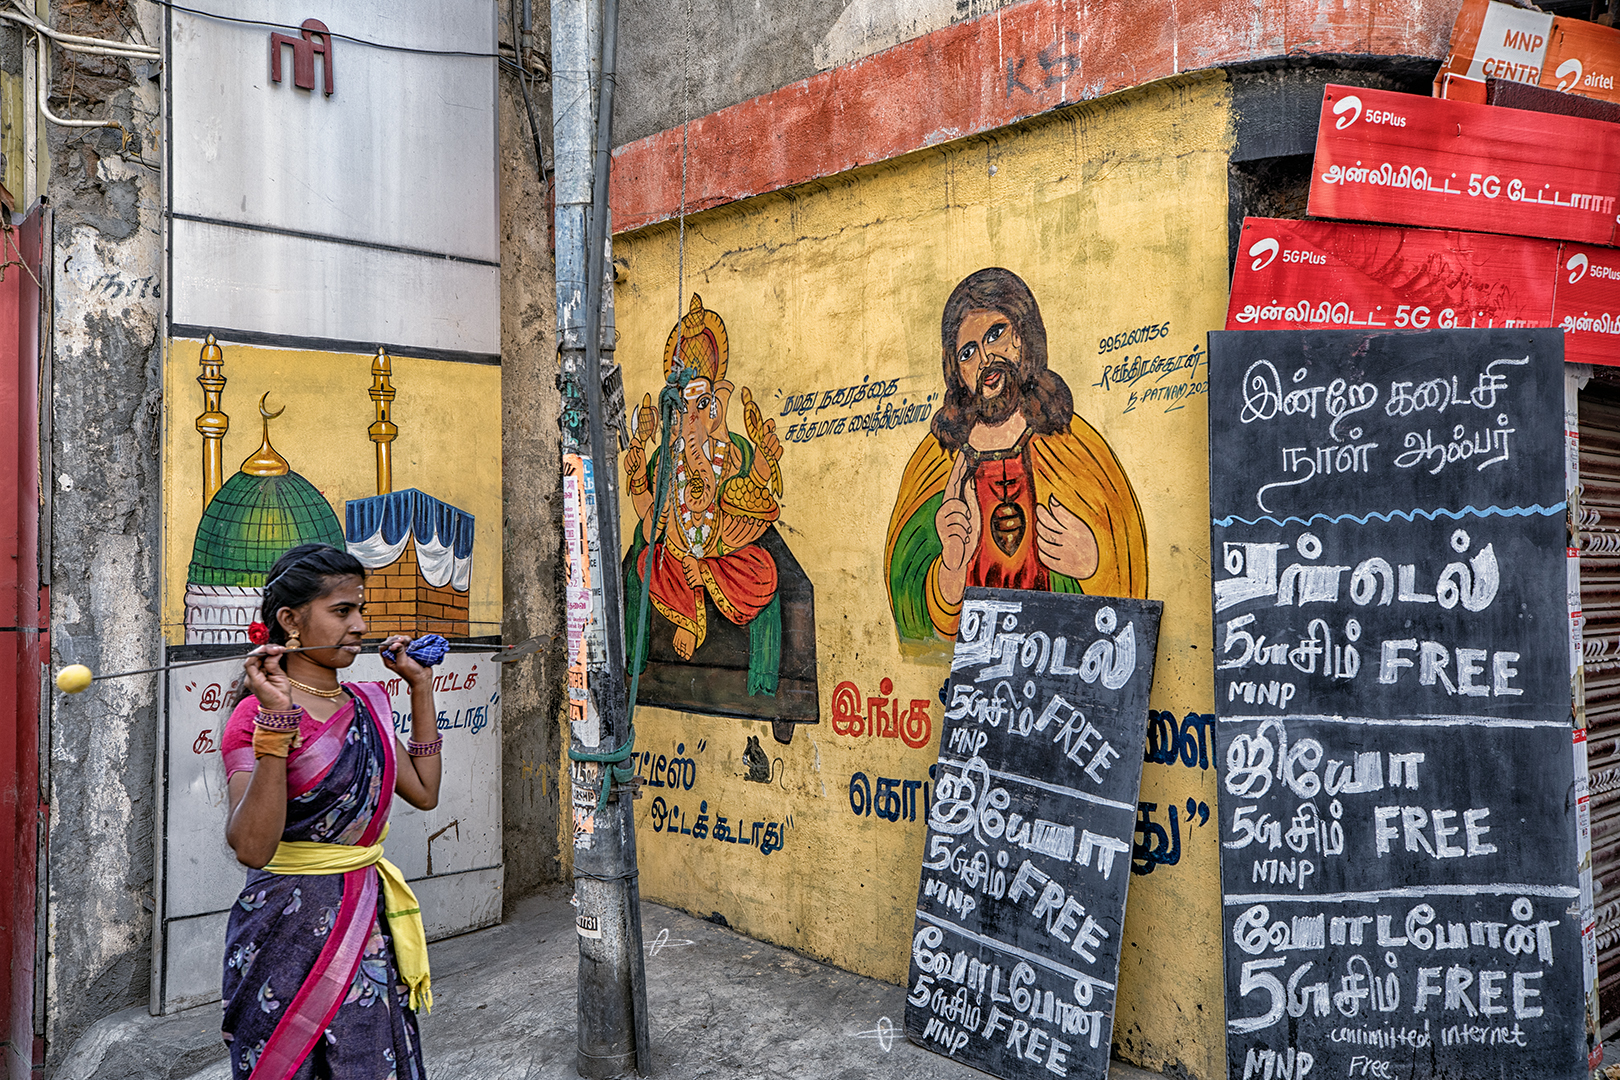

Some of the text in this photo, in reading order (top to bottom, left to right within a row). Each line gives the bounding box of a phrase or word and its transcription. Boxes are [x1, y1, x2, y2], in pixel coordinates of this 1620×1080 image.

[1503, 29, 1544, 53] MNP
[1584, 72, 1614, 90] airtel
[1321, 160, 1461, 195] அன்லிமிடெட்
[1467, 173, 1501, 198] 5G
[1098, 321, 1170, 355] 9952601136
[1235, 300, 1387, 327] அன்லிமிடெட்
[1393, 305, 1431, 328] 5G
[1240, 356, 1529, 442] இன்றே கடைசி
[1256, 427, 1378, 513] நாள்
[1215, 529, 1500, 612] ஏர்டெல்
[951, 600, 1136, 690] ஏர்டெல்
[1380, 639, 1524, 697] FREE
[832, 677, 931, 748] இங்கு
[1228, 680, 1296, 709] MNP
[949, 728, 988, 757] MNP
[1033, 694, 1120, 784] FREE
[1224, 718, 1425, 799] ஜியோ
[928, 756, 1129, 880] ஜியோ
[1374, 805, 1498, 859] FREE
[924, 878, 976, 920] MNP
[1252, 858, 1314, 890] MNP
[1008, 860, 1109, 964] FREE
[1233, 897, 1560, 966] வோடபோன்
[1414, 963, 1544, 1019] FREE
[923, 1017, 969, 1055] MNP
[981, 1006, 1072, 1077] FREE
[1243, 1048, 1315, 1080] MNP
